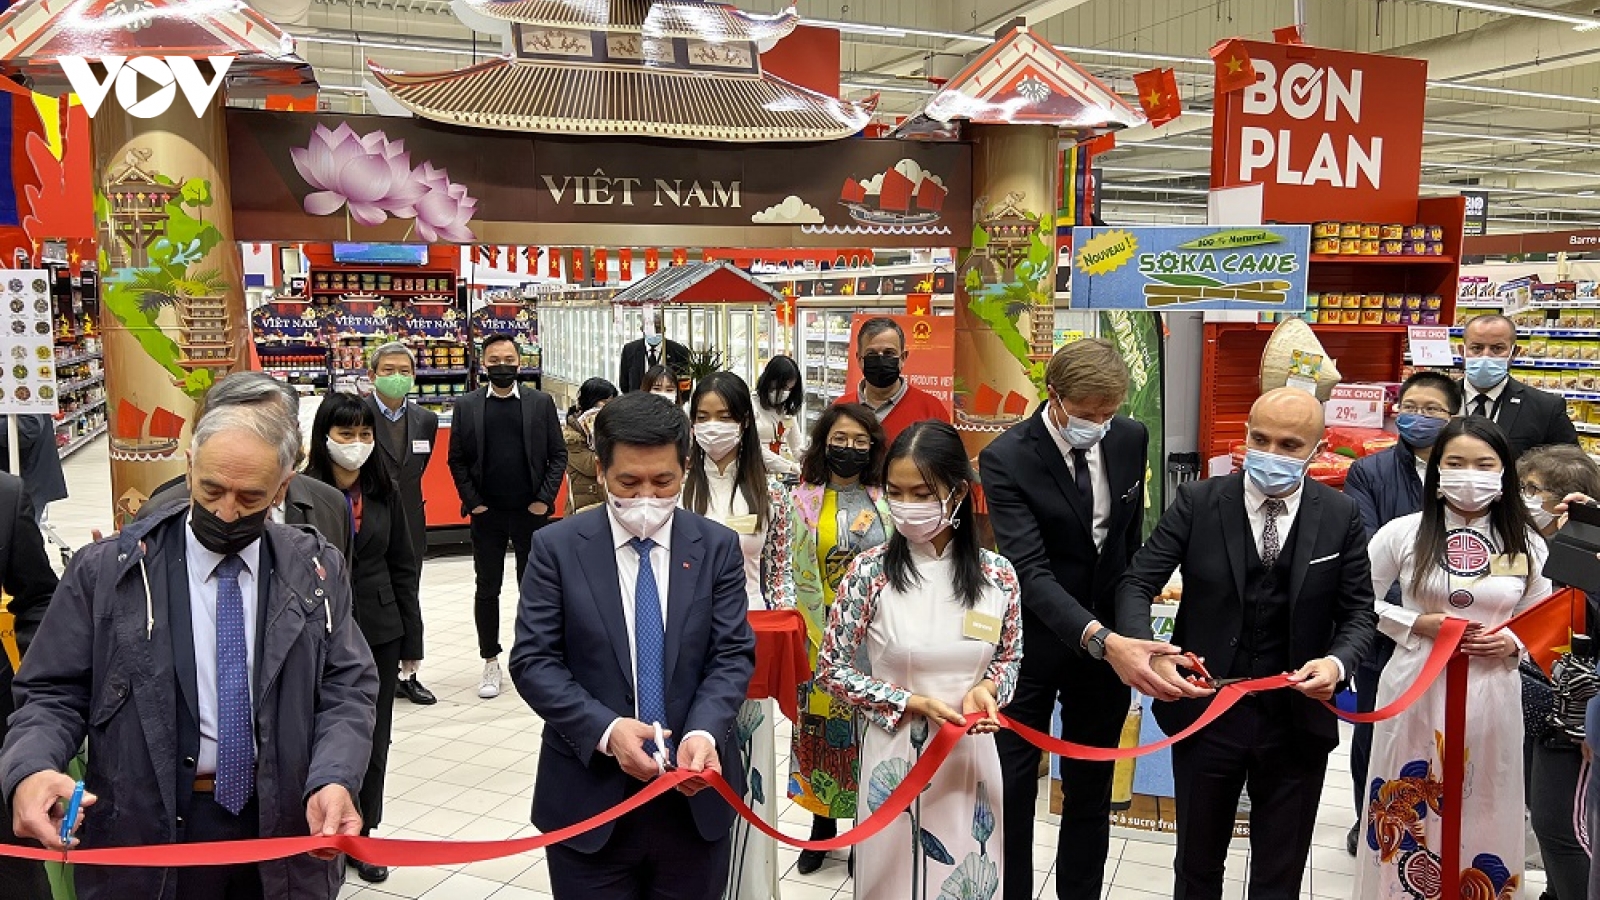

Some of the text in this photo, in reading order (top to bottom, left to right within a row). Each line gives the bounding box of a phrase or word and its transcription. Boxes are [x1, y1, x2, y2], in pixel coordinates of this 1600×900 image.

[1243, 58, 1363, 124] BON
[1240, 126, 1383, 190] PLAN
[541, 168, 742, 208] VIÊT NAM
[1569, 235, 1597, 245] Barre
[1082, 241, 1126, 267] NOUVEAU
[1138, 252, 1297, 273] SOKA CANE
[292, 319, 318, 328] NAM
[364, 316, 389, 326] NAM
[434, 320, 458, 329] NAM
[507, 320, 531, 329] NAM
[1331, 388, 1380, 399] PRIX CHOC
[1120, 814, 1126, 823] à
[1127, 817, 1156, 828] sucre
